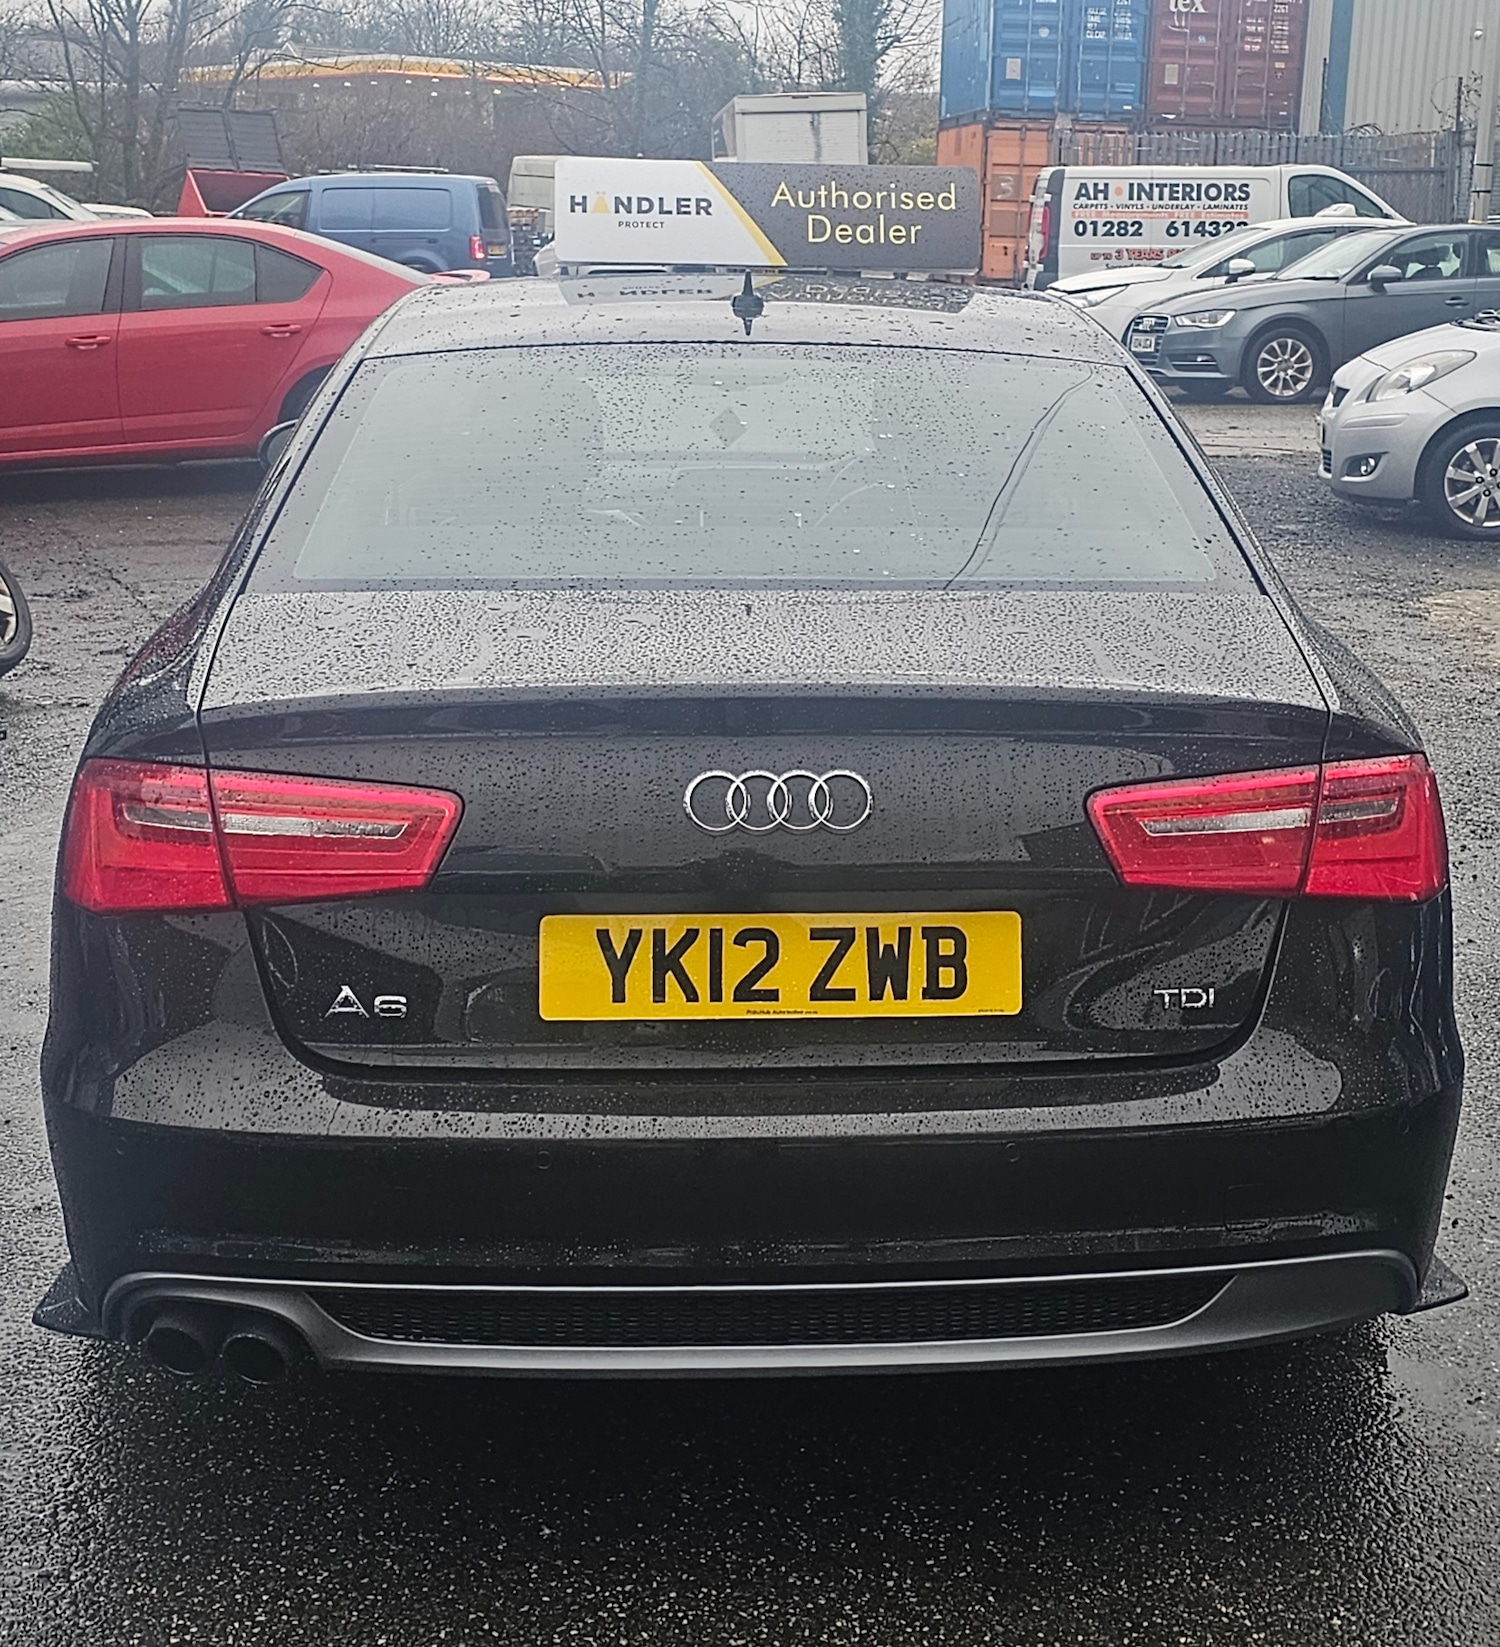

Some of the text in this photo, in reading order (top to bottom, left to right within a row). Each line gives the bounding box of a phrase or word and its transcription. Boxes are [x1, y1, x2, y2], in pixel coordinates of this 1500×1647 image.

[770, 180, 956, 211] Authorised
[1074, 182, 1251, 202] AH INTERIORS
[1174, 211, 1196, 219] FREE
[1202, 203, 1248, 211] LAMINATES
[618, 220, 665, 229] PROTECT
[807, 214, 922, 245] Dealer
[1074, 220, 1144, 237] 01282
[1114, 248, 1124, 261] 3
[1125, 247, 1164, 261] YEARS
[595, 925, 968, 1004] YK12 ZWB
[324, 984, 408, 1019] A6
[1153, 987, 1216, 1010] TDI
